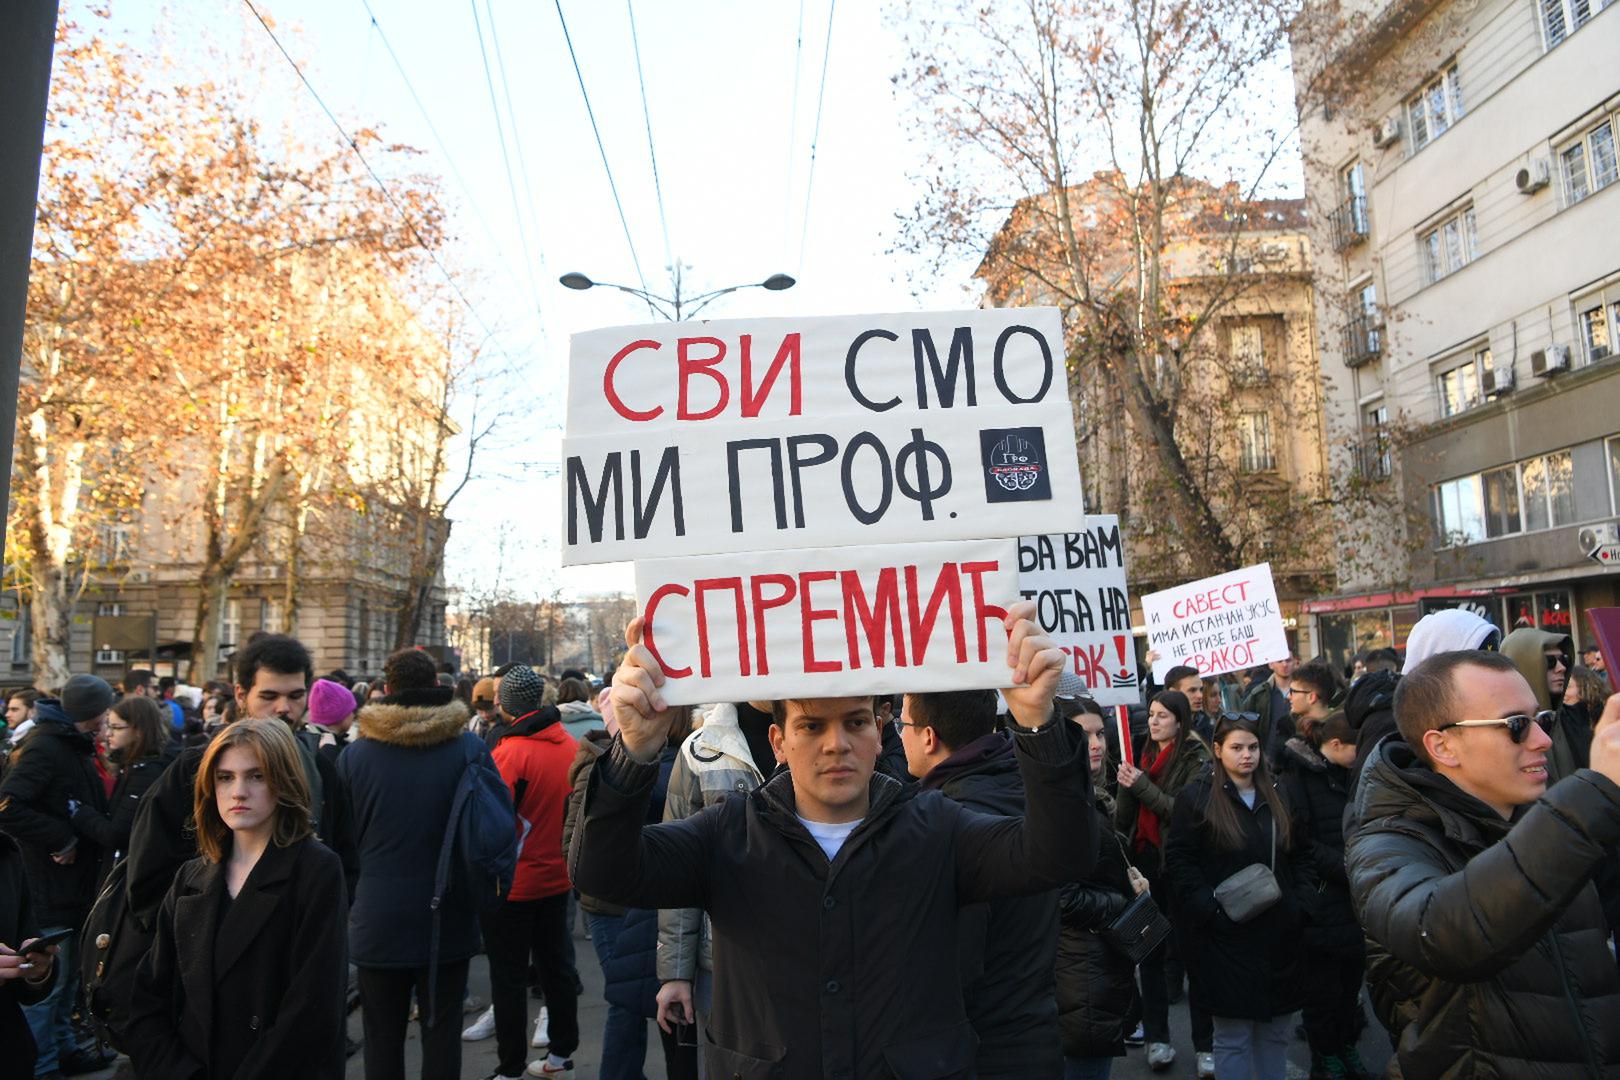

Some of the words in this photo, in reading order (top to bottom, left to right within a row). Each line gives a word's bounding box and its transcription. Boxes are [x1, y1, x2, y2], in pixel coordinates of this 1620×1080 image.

[604, 332, 802, 422] СВИ
[844, 325, 1053, 412] СМО
[567, 446, 686, 546] МИ
[727, 428, 958, 534] ПРОФ.
[1063, 525, 1123, 570] ВАМ
[644, 560, 1012, 678] СПРЕМИЋ
[1098, 587, 1131, 631] НА
[1173, 580, 1250, 619] САВЕСТ
[1152, 628, 1180, 645] ИМА
[1182, 608, 1244, 638] ИСТАНЧАН
[1172, 643, 1188, 658] НЕ
[1192, 631, 1227, 653] ГРИЗЕ
[1230, 624, 1254, 642] БАШ
